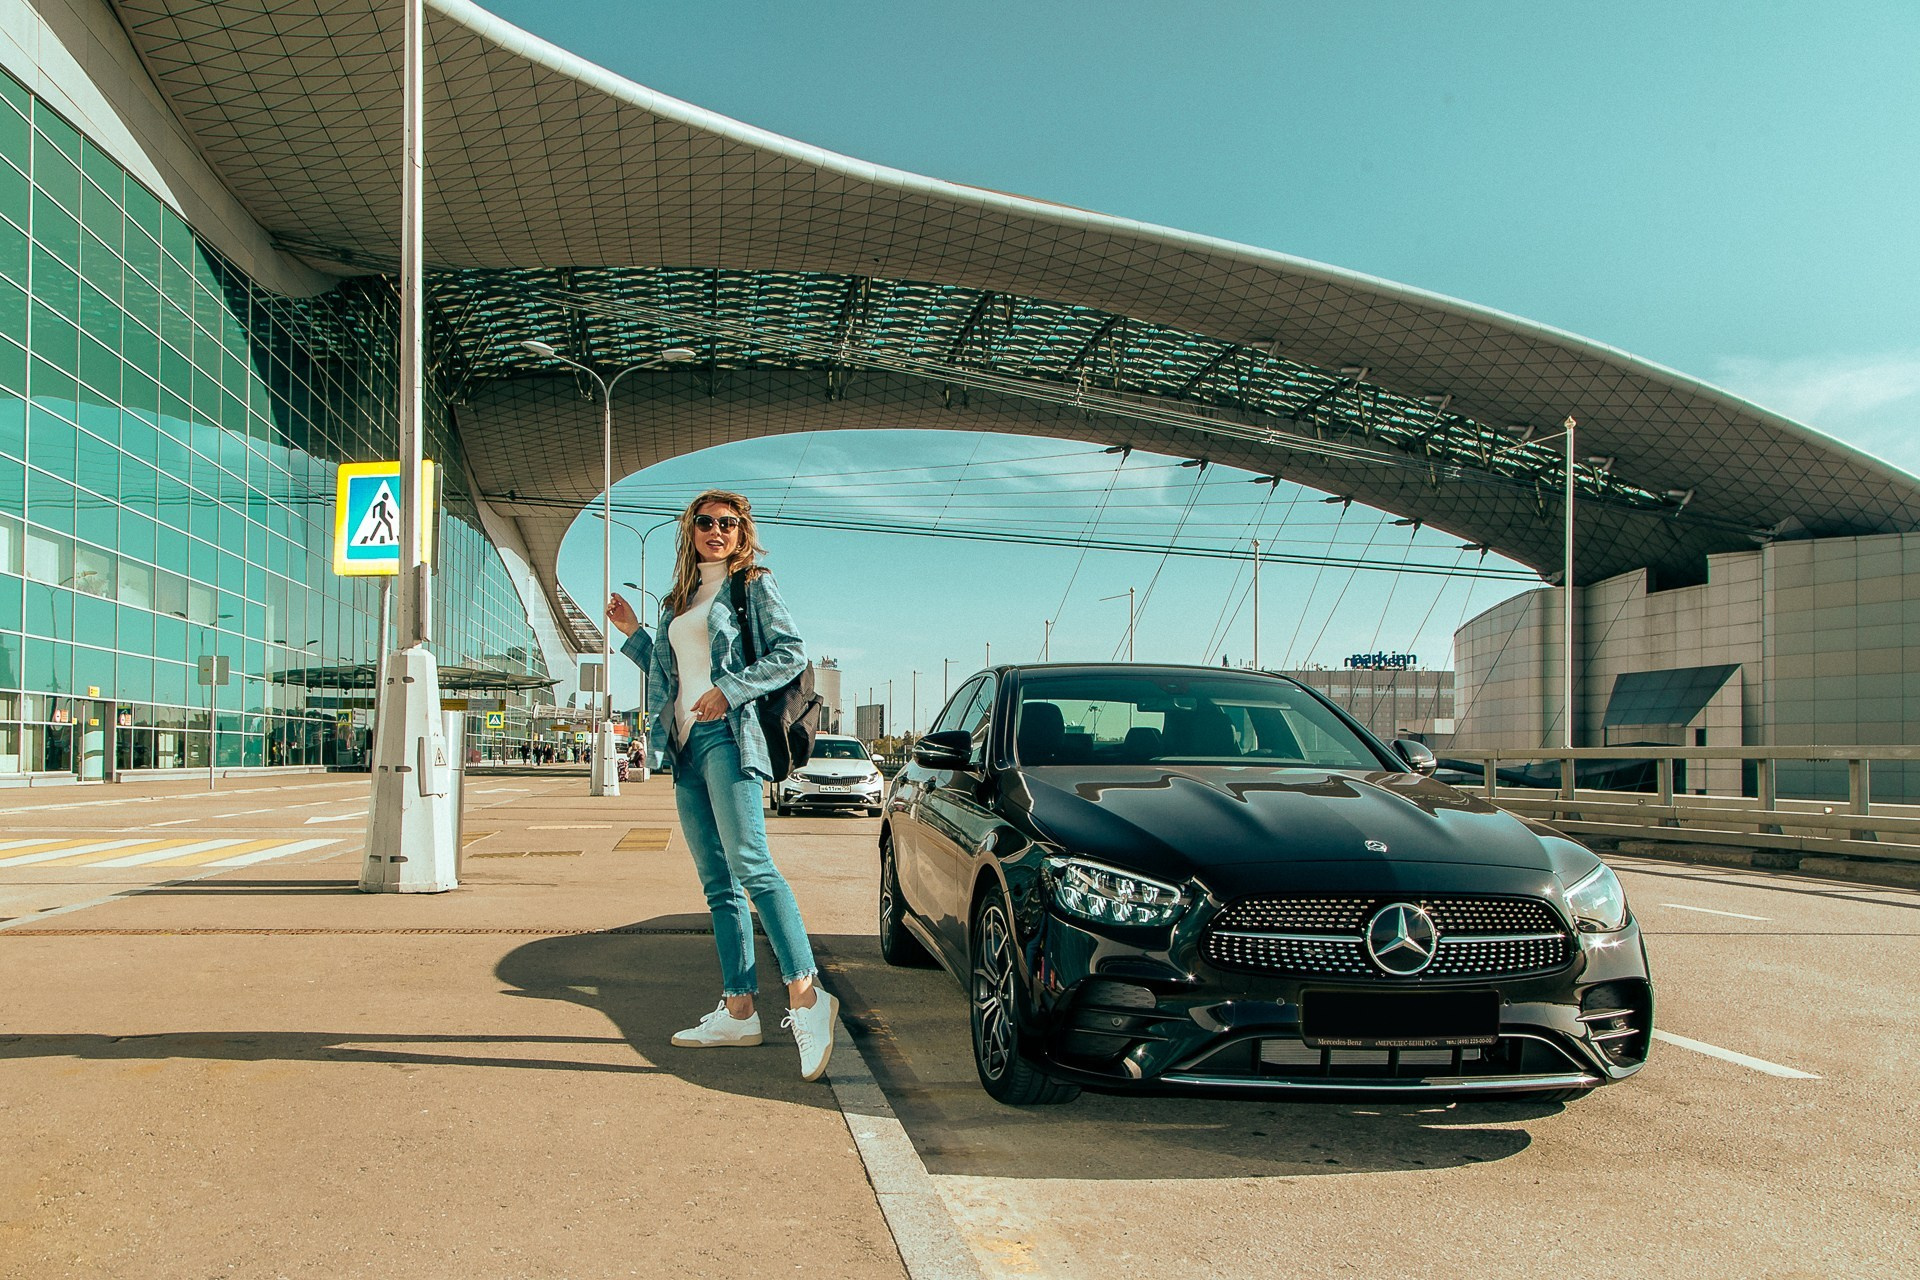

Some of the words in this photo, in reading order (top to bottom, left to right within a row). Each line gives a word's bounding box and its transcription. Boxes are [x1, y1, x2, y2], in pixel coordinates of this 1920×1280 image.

[1352, 651, 1388, 667] park
[1392, 651, 1417, 664] inn
[1317, 1038, 1362, 1046] Mercedes-Benz
